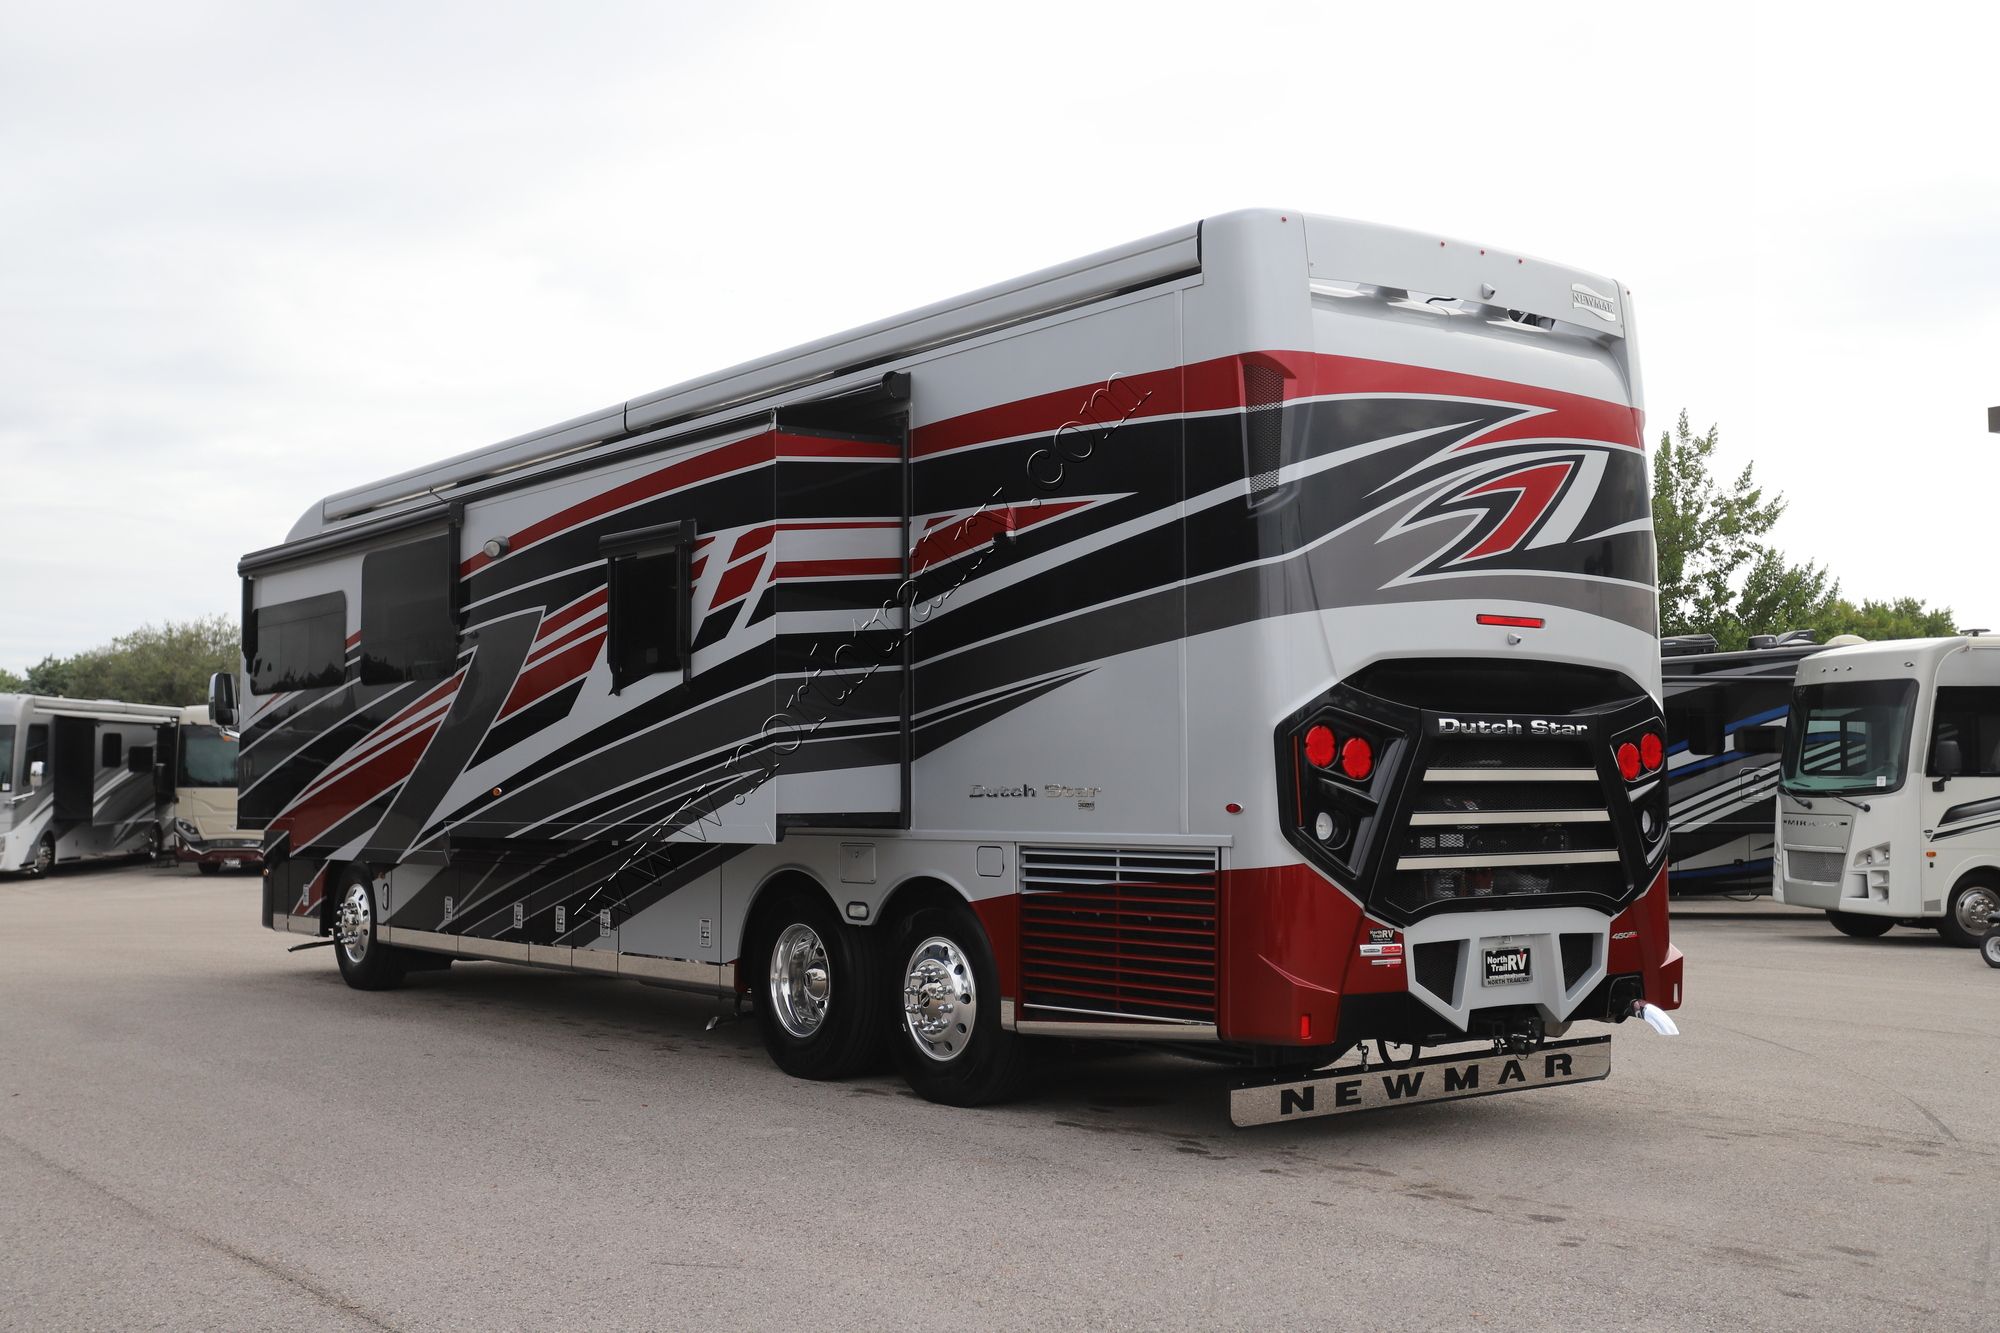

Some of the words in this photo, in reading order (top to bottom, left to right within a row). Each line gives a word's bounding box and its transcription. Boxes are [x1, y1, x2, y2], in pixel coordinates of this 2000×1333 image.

[1572, 292, 1615, 313] NEWMAR
[1438, 717, 1523, 735] Dutch
[1530, 719, 1588, 736] Star
[969, 783, 1037, 799] Dutch
[1044, 783, 1102, 799] Star
[1382, 930, 1394, 938] RV
[1487, 956, 1507, 964] North
[1491, 964, 1508, 972] Trail
[1507, 954, 1527, 971] RV
[1280, 1053, 1573, 1115] NEWMAR
